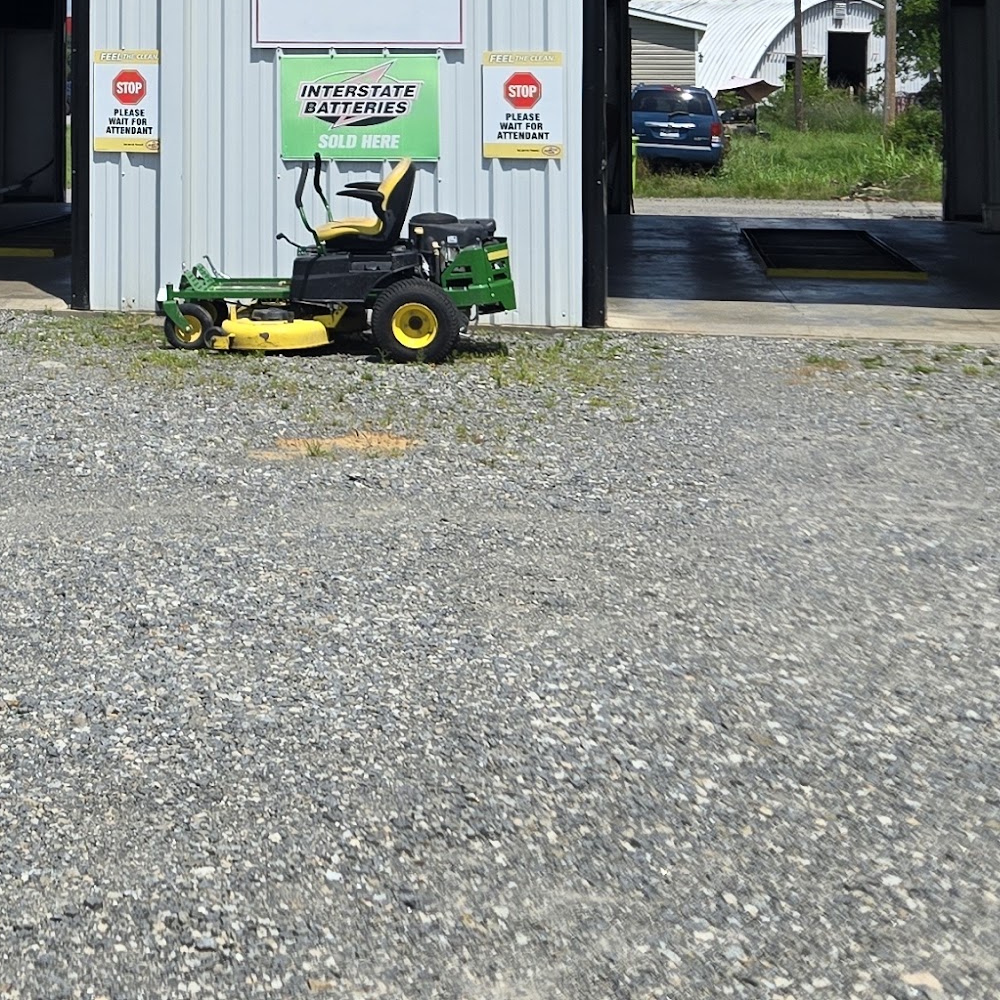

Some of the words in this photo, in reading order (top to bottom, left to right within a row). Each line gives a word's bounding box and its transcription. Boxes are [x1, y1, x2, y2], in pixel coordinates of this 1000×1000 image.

[100, 53, 122, 61] FEEL
[489, 54, 514, 63] FEEL
[116, 81, 142, 94] STOP
[301, 85, 416, 97] INTERSTATE
[508, 84, 537, 98] STOP
[304, 101, 408, 114] BATTERIES
[114, 109, 145, 117] PLEASE
[505, 113, 540, 121] PLEASE
[106, 126, 153, 134] ATTENDANT
[500, 122, 522, 130] WAIT
[525, 122, 543, 130] FOR
[497, 132, 550, 140] ATTENDANT
[318, 134, 357, 149] SOLD
[361, 134, 400, 149] HERE
